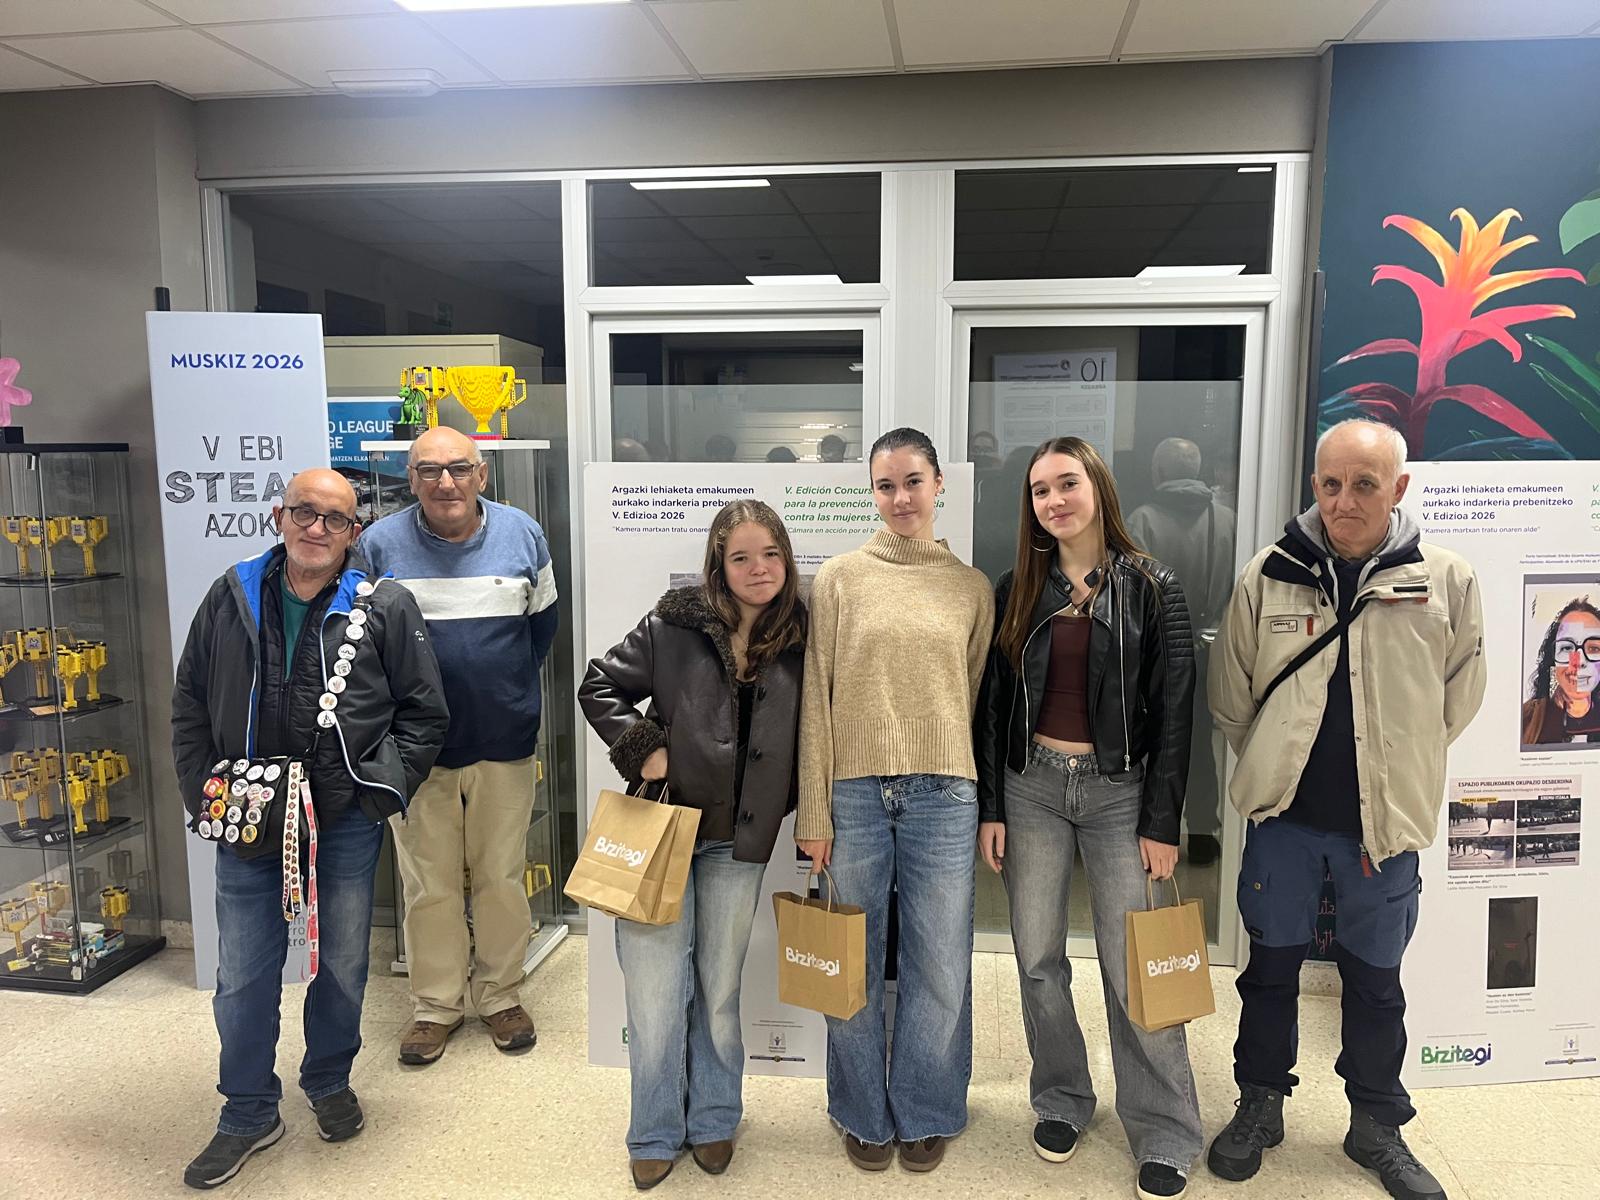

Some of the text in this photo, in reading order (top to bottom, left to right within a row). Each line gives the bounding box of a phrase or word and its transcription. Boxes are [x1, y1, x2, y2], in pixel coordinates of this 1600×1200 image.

[171, 353, 304, 370] MUSKIZ 2026
[339, 420, 394, 434] LEAGUE
[202, 435, 283, 461] V EBI
[165, 470, 298, 504] STEA
[611, 485, 755, 497] Argazki lehiaketa emakumeen
[784, 485, 874, 495] V. Edición Concurs
[1422, 484, 1564, 496] Argazki lehiaketa emakumeen
[611, 498, 650, 507] aurkako
[652, 498, 700, 507] indarkeria
[783, 500, 806, 509] para
[808, 499, 817, 508] la
[819, 499, 873, 509] prevención
[1422, 497, 1574, 508] aurkako indarkeria prebenitzeko
[612, 511, 685, 520] V. Edizioa 2026
[784, 513, 815, 522] contra
[817, 513, 831, 522] las
[833, 513, 871, 524] mujeres
[1422, 511, 1496, 521] V. Edizioa 2026
[205, 512, 282, 538] AZOK
[825, 526, 847, 534] acción
[848, 527, 861, 536] por
[862, 526, 869, 534] el
[1452, 526, 1480, 534] martxan
[593, 836, 647, 867] Bizitegi
[785, 946, 840, 977] Bizitegi
[1147, 949, 1200, 977] Bizitegi
[1421, 1043, 1491, 1066] Bizitegi
